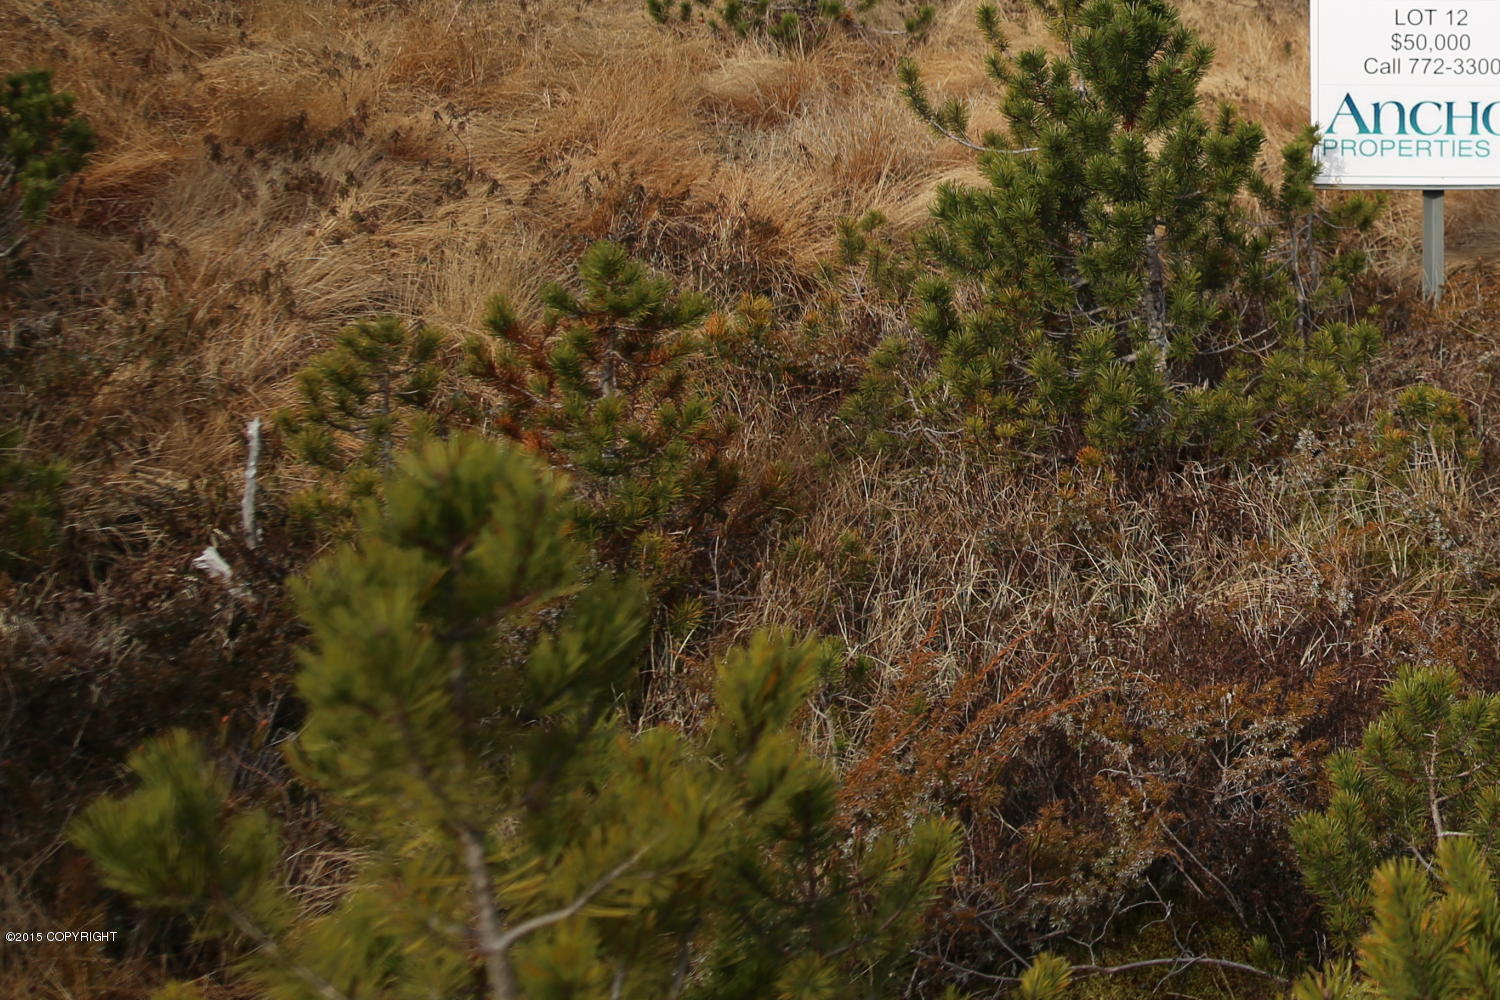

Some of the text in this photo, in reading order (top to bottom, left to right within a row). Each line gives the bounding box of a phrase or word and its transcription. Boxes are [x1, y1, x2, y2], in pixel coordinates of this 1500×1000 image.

[1394, 9, 1468, 26] LOT 12
[1391, 32, 1471, 52] $50,000
[1363, 57, 1500, 75] Call 772-3300
[1323, 139, 1490, 158] PROPERTIES
